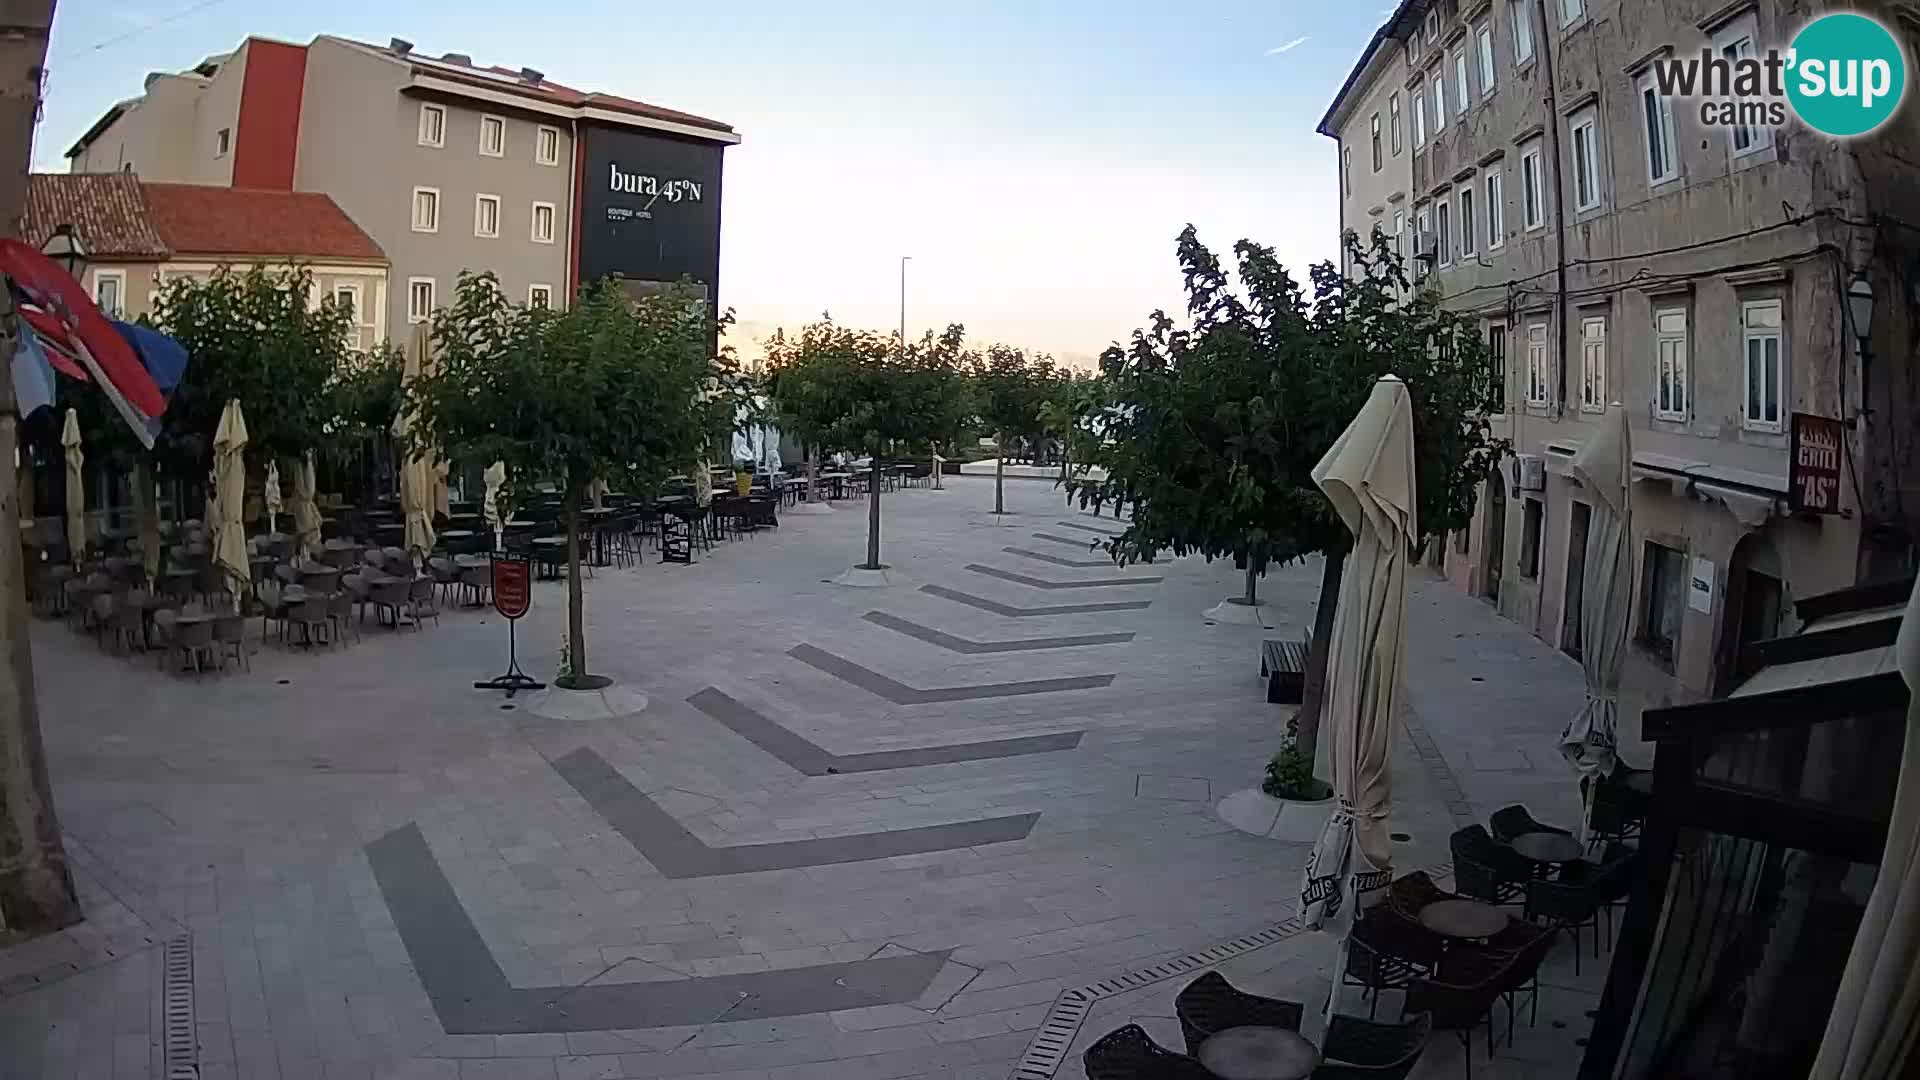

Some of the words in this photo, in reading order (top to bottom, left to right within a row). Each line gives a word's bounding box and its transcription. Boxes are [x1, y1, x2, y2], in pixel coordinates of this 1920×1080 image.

[611, 164, 657, 196] bura
[608, 208, 633, 217] BOUTIQUE
[636, 211, 652, 219] HOTEL
[1799, 447, 1838, 470] GRILL
